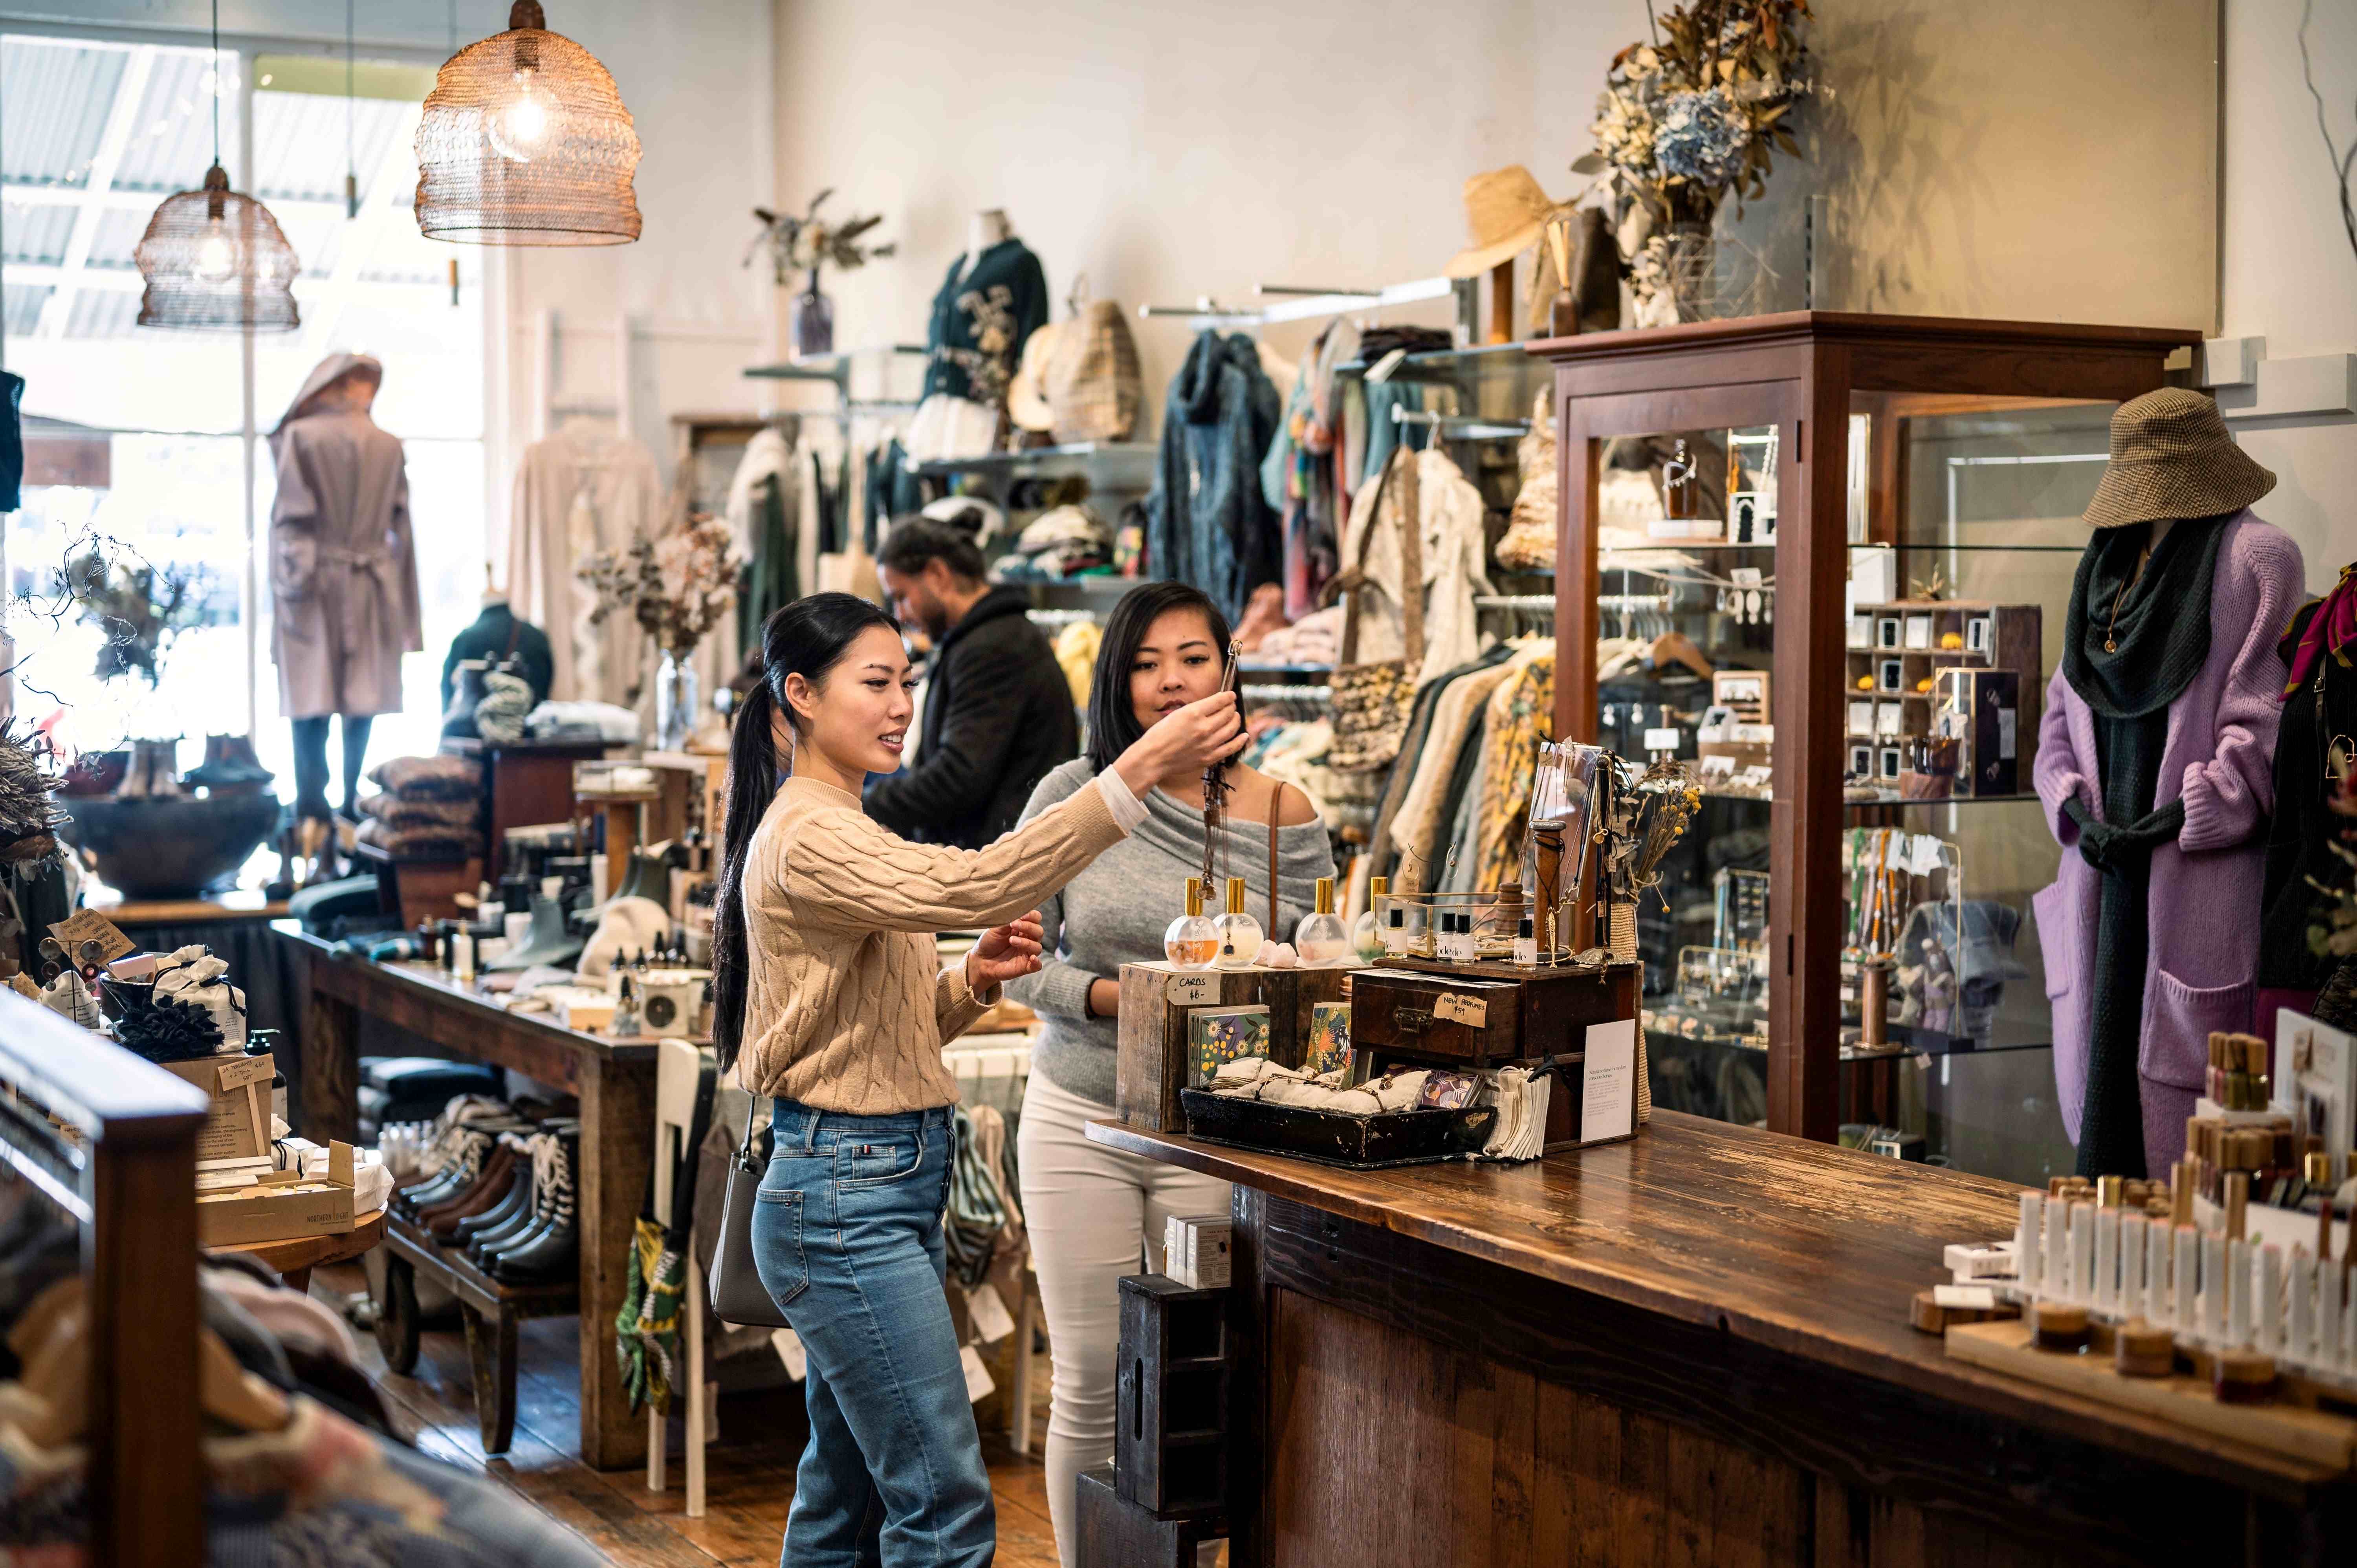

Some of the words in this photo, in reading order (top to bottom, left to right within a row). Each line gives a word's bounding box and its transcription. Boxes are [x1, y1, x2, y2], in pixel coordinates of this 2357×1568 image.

[1179, 978, 1206, 987] CARDS
[1461, 998, 1485, 1010] PERFUMES
[1454, 1006, 1465, 1016] $59
[307, 1213, 332, 1223] NORTHERN
[336, 1211, 349, 1220] LIGHT
